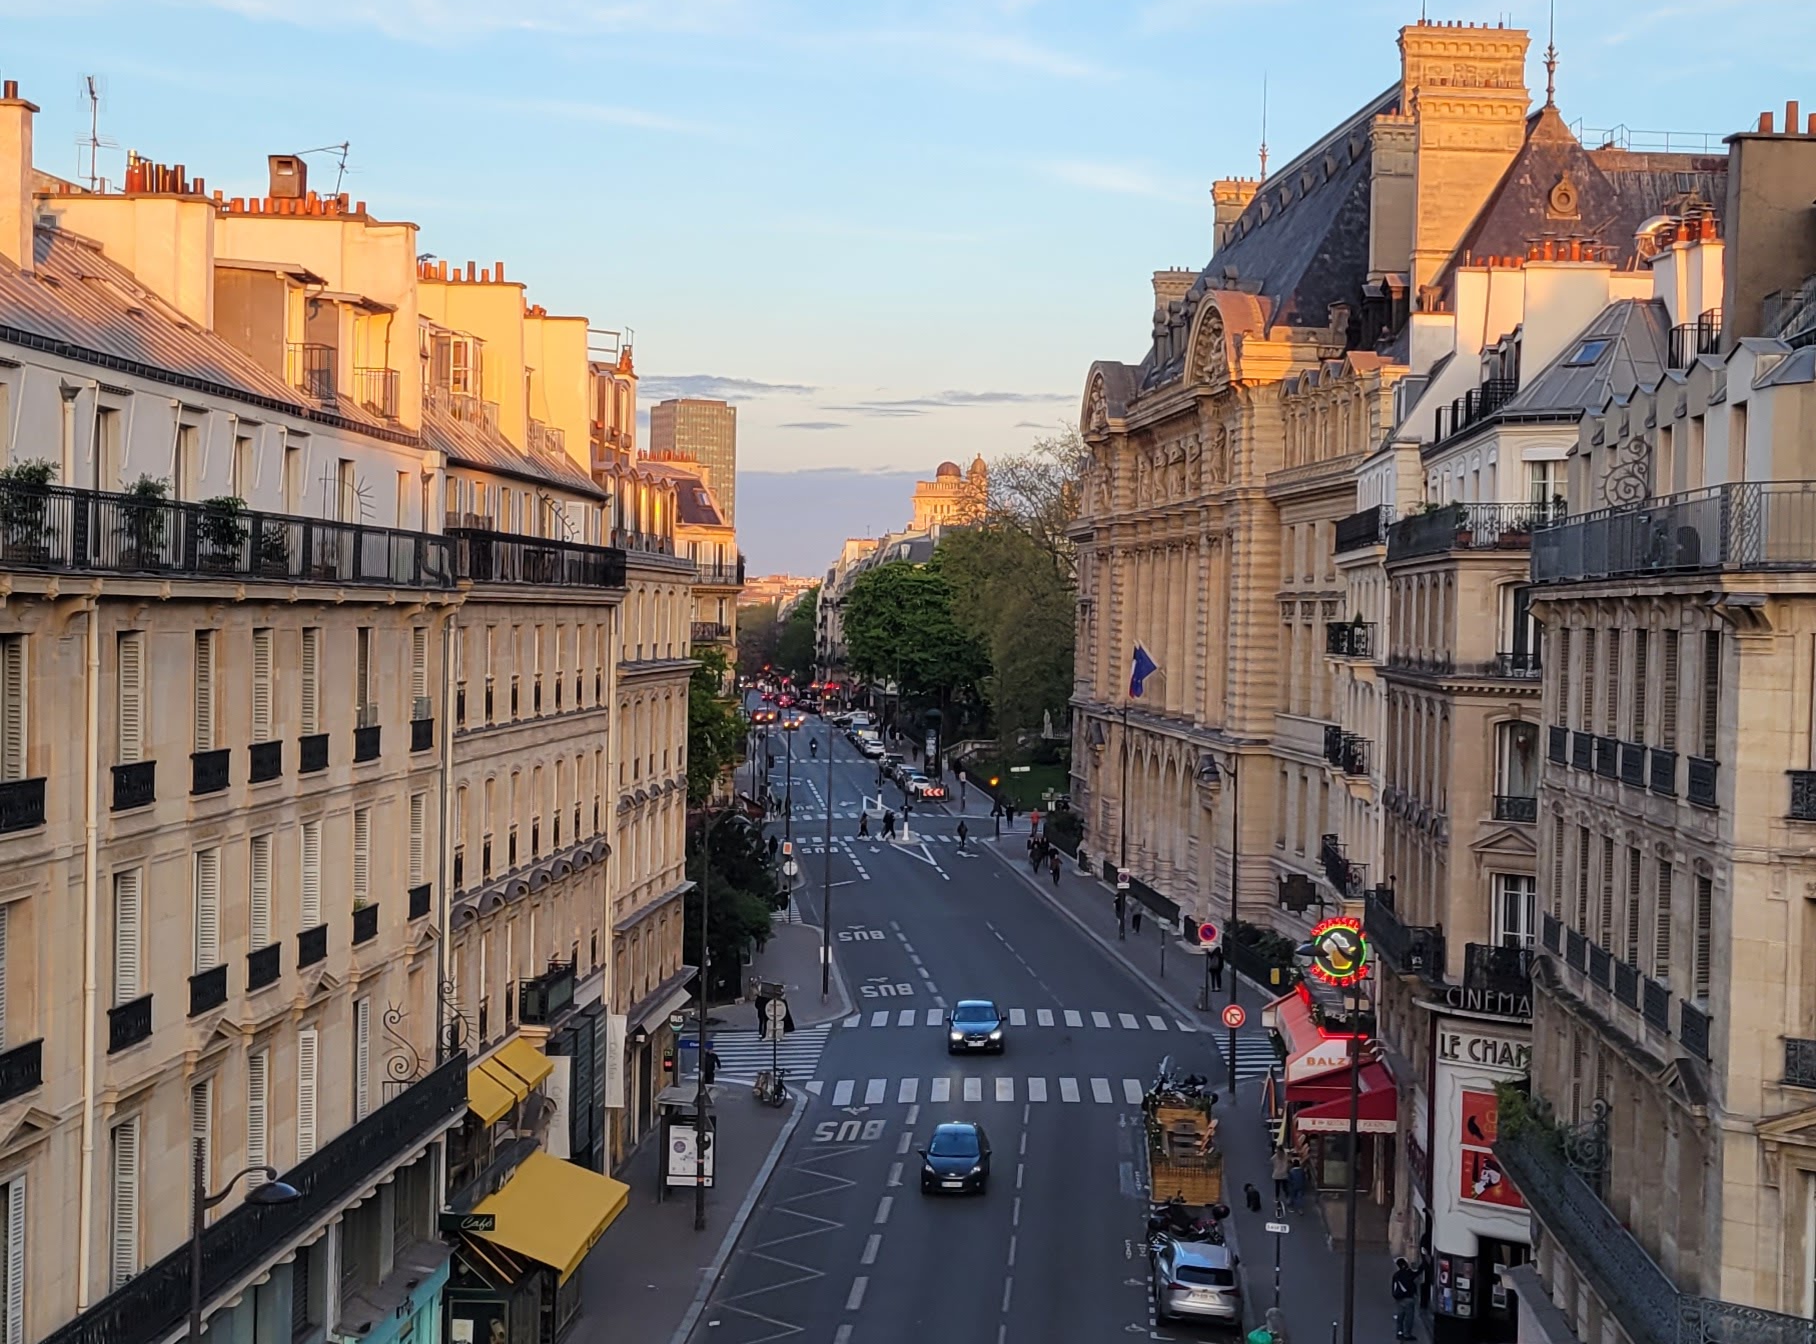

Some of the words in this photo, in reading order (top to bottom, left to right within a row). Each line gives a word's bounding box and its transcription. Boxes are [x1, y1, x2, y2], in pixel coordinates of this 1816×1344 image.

[838, 930, 885, 941] BUS
[1311, 917, 1368, 938] BRASSERE
[860, 983, 914, 997] BUS
[1446, 986, 1532, 1017] CINEMA
[671, 1015, 684, 1023] BUS
[1440, 1033, 1461, 1059] LE
[812, 1119, 887, 1142] BUS
[461, 1216, 493, 1231] Café
